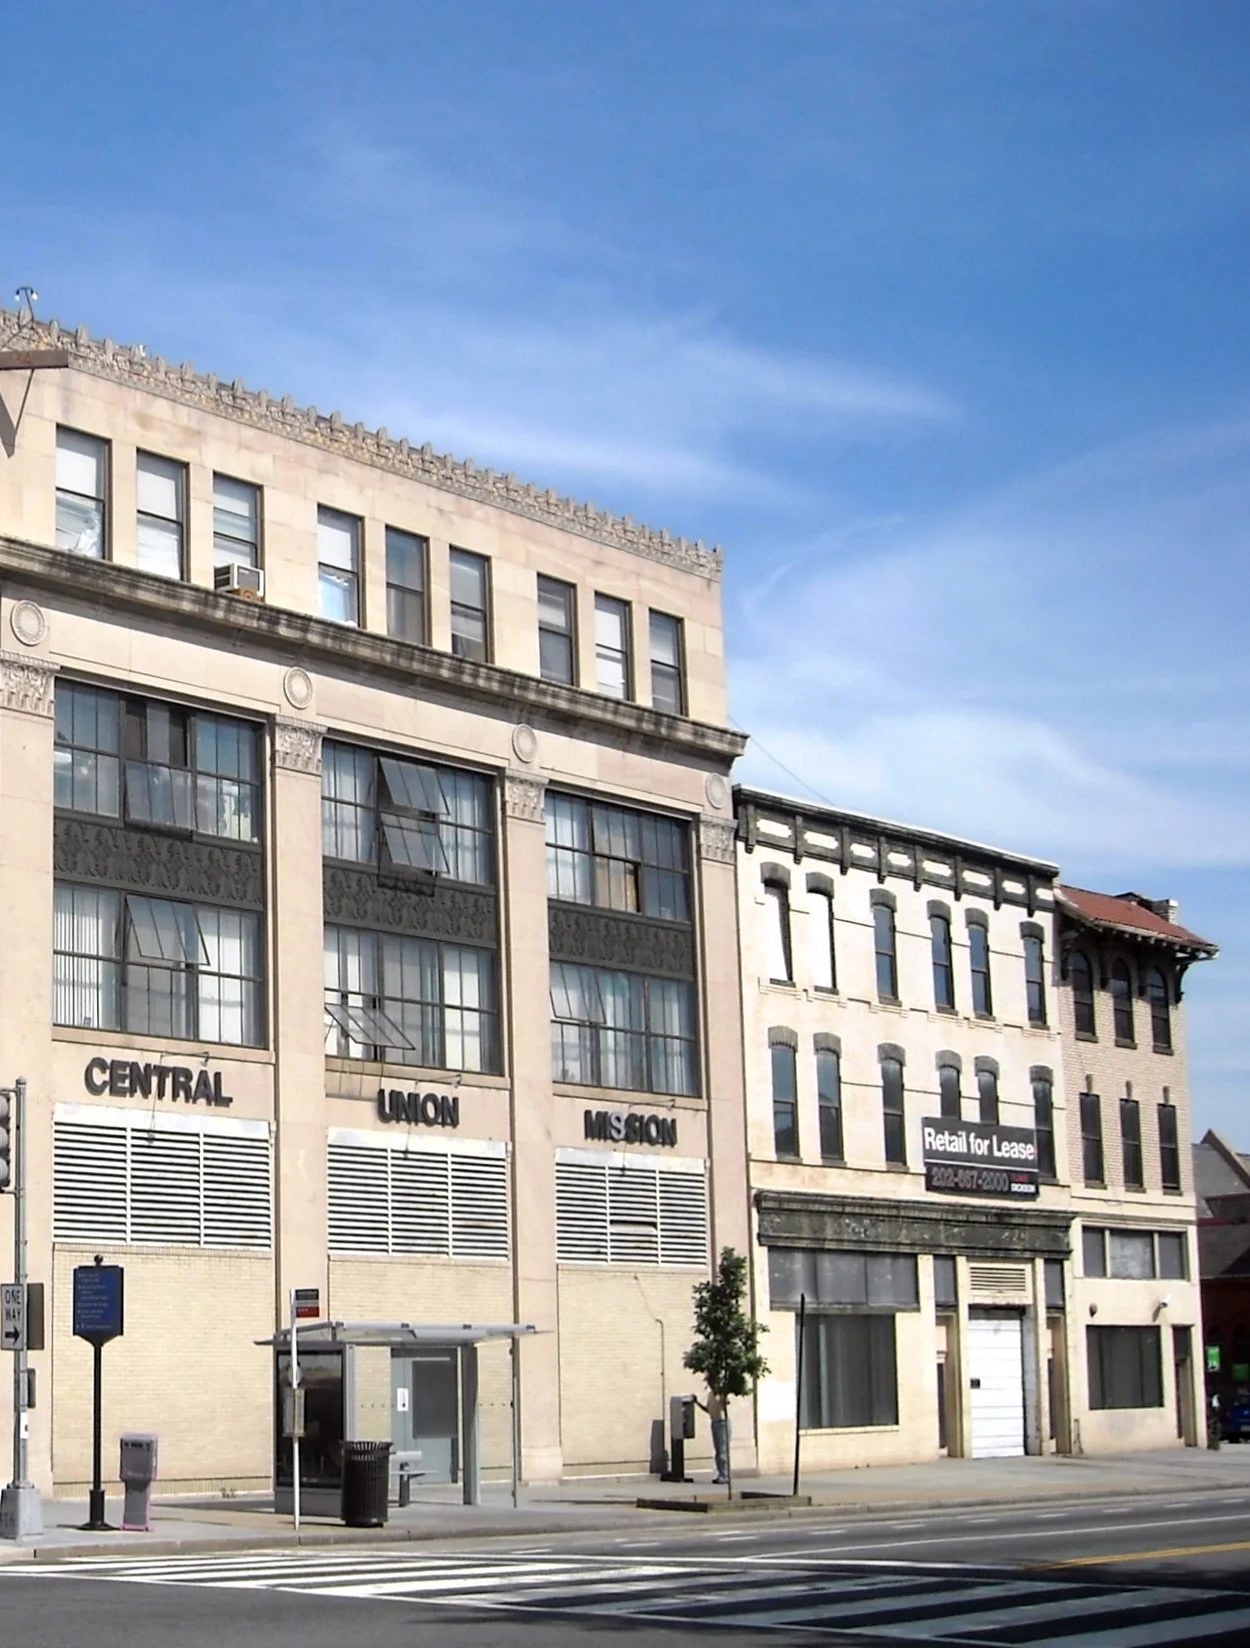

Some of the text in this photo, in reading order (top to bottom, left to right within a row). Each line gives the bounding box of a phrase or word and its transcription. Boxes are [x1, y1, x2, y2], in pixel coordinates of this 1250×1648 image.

[84, 1057, 678, 1147] CENTRAL UNION MISSION
[923, 1127, 1035, 1160] Retail for Lease
[4, 1289, 21, 1304] ONE
[4, 1307, 22, 1321] WAY
